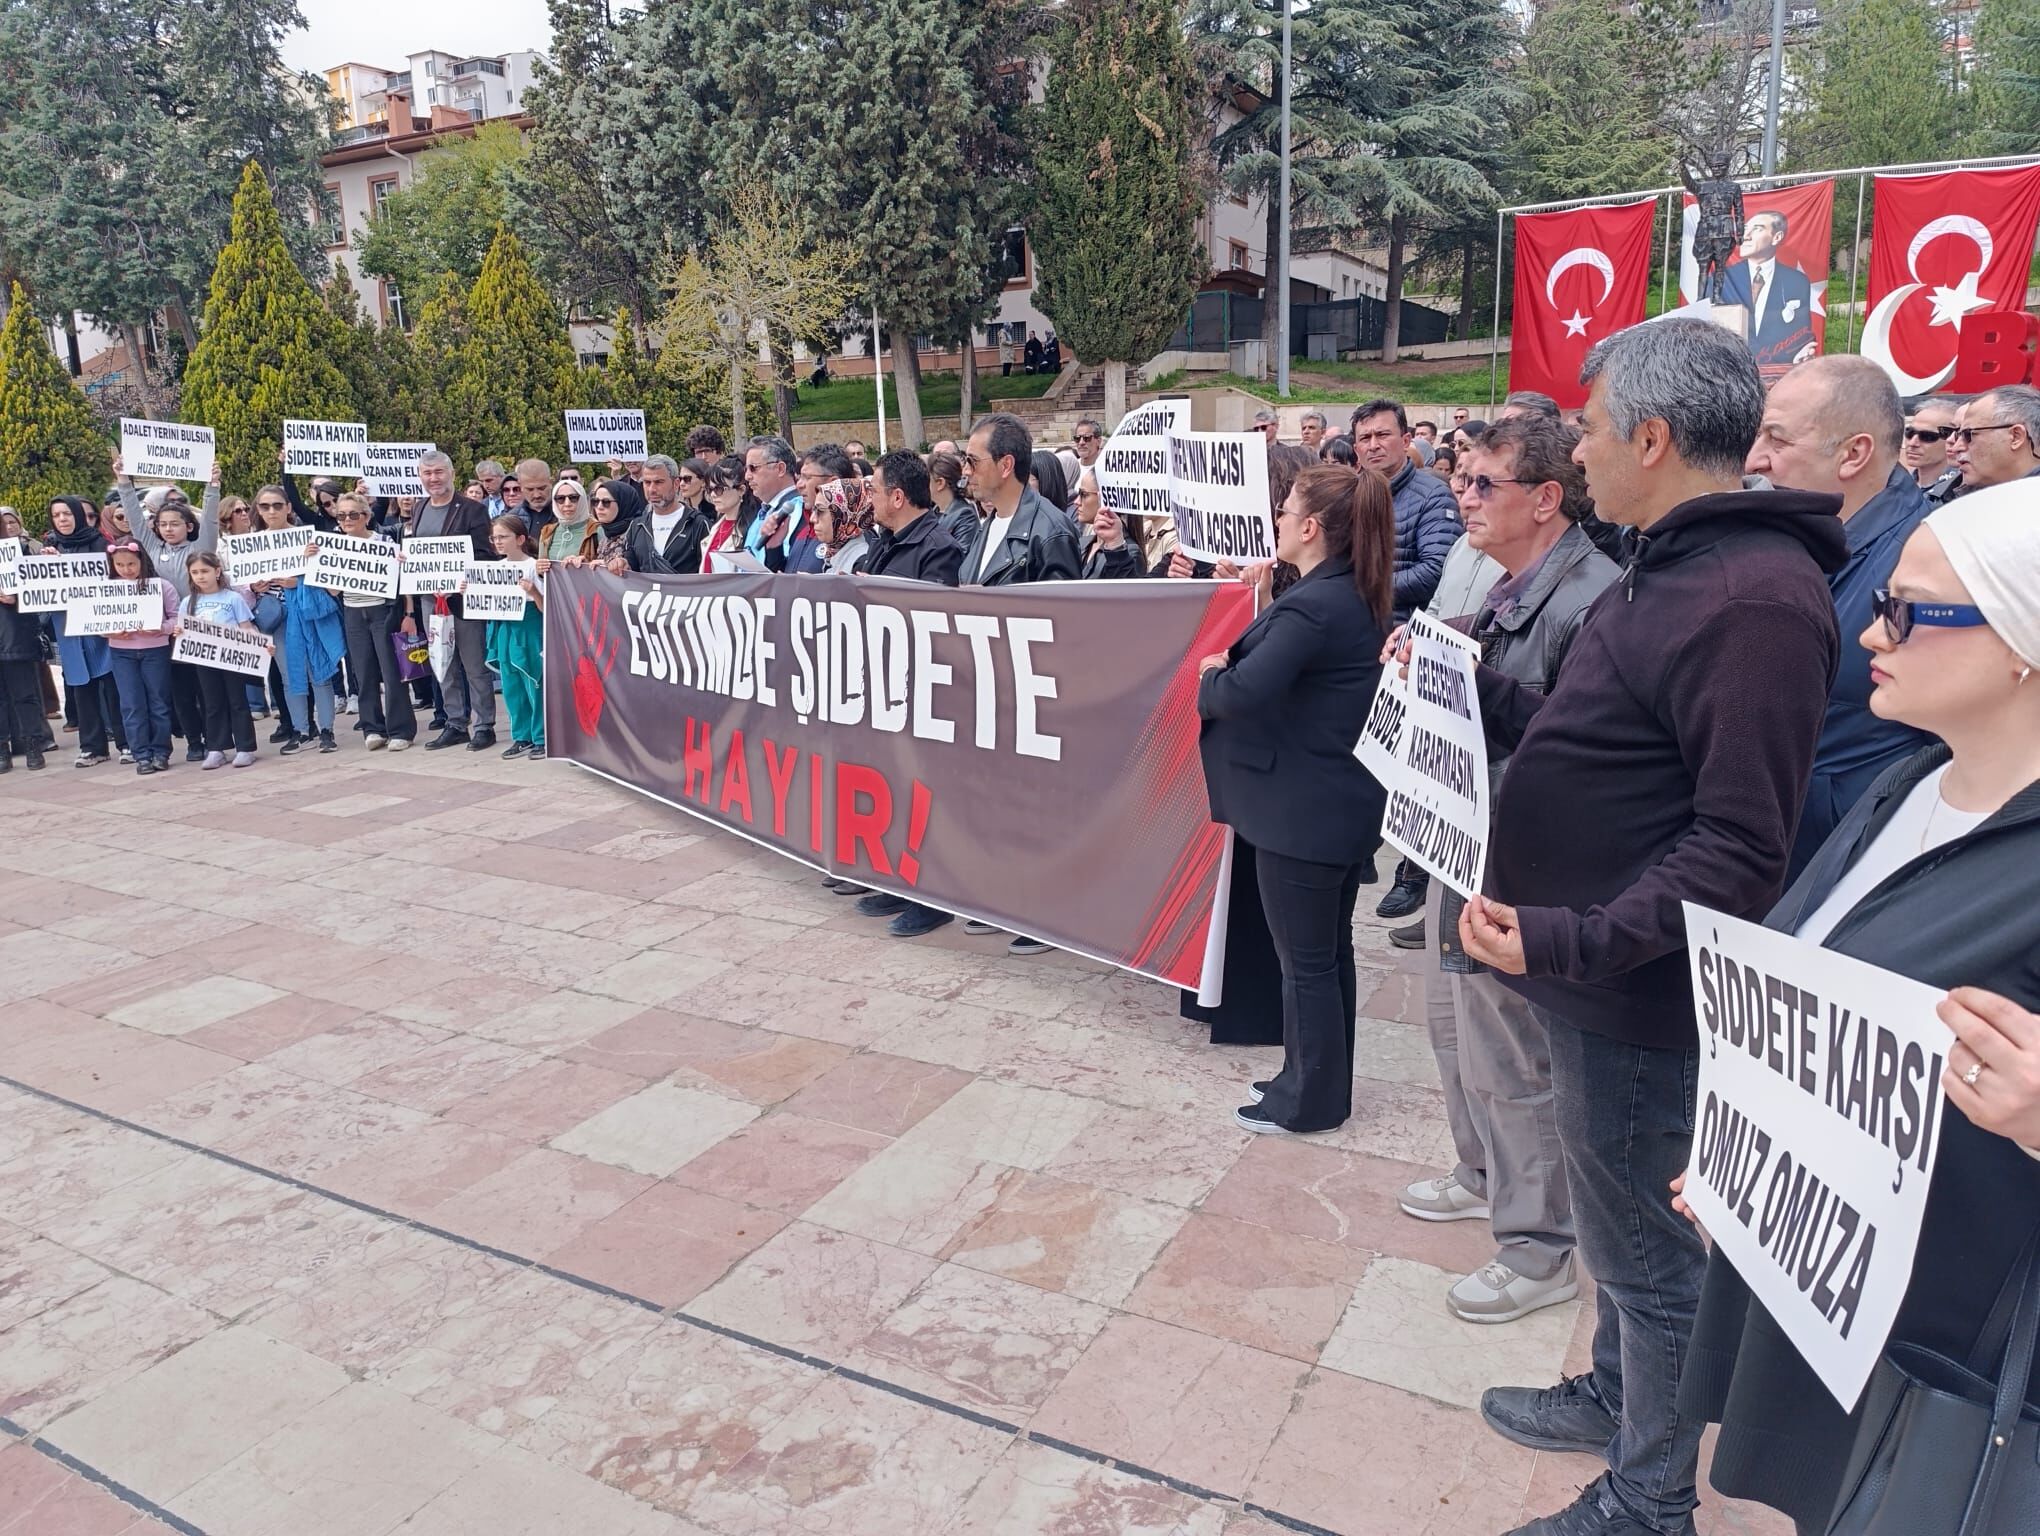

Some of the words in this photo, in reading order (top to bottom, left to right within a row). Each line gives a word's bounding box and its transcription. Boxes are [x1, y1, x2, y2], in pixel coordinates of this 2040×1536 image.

[1955, 312, 2040, 394] B
[286, 423, 322, 441] SUSMA
[326, 425, 365, 443] HAYKIR
[568, 412, 597, 431] İHMAL
[599, 412, 643, 431] ÖLDÜRÜR
[123, 423, 151, 437] ADALET
[153, 425, 179, 441] YERİNİ
[181, 429, 213, 446] BULSUN,
[147, 442, 190, 460] VİCDANLAR
[287, 445, 330, 469] ŞİDDETE
[334, 451, 360, 468] HAYI
[573, 440, 605, 454] ADALET
[606, 440, 644, 459] YAŞATIR
[137, 462, 163, 476] HUZUR
[165, 465, 196, 478] DOLSUN
[363, 465, 401, 477] UZANAN
[1105, 450, 1167, 474] KARARMASI
[1211, 441, 1245, 486] ACISI
[379, 483, 423, 495] KIRILSIN
[1101, 481, 1140, 510] SESİMİZİ
[1143, 489, 1170, 513] DUYU
[230, 535, 271, 555] SUSMA
[1207, 511, 1271, 558] ACISIDIR.
[315, 535, 396, 558] OKULLARDA
[409, 540, 465, 555] ÖĞRETMENE
[18, 560, 69, 585] ŞİDDETE
[71, 560, 109, 581] KARŞI
[233, 559, 278, 582] ŞİDDETE
[319, 553, 388, 575] GÜVENLİK
[403, 561, 440, 573] UZANAN
[68, 585, 97, 599] ADALET
[99, 582, 125, 598] YERİNİ
[315, 569, 388, 594] İSTİYORUZ
[416, 579, 456, 591] KIRILSIN
[23, 589, 57, 606] OMUZ
[466, 594, 492, 610] ADALET
[494, 595, 523, 616] YAŞATIR
[93, 603, 138, 616] VİCDANLAR
[84, 623, 110, 632] HUZUR
[112, 620, 144, 631] DOLSUN
[180, 635, 217, 659] ŞİDDETE
[220, 647, 261, 670] KARŞIYIZ
[622, 583, 776, 707] EĞİTİMDE
[790, 597, 1061, 761] ŞİDDETE
[1407, 725, 1478, 816] KARARMASIN,
[683, 715, 932, 888] HAYIR!
[1387, 788, 1440, 857] SESİMİZİ
[1429, 818, 1482, 892] DUYUN!
[1699, 927, 1818, 1096] ŞİDDETE
[1825, 1002, 1942, 1194] KARŞI
[1698, 1090, 1772, 1229] OMUZ
[1758, 1150, 1877, 1341] OMUZA
